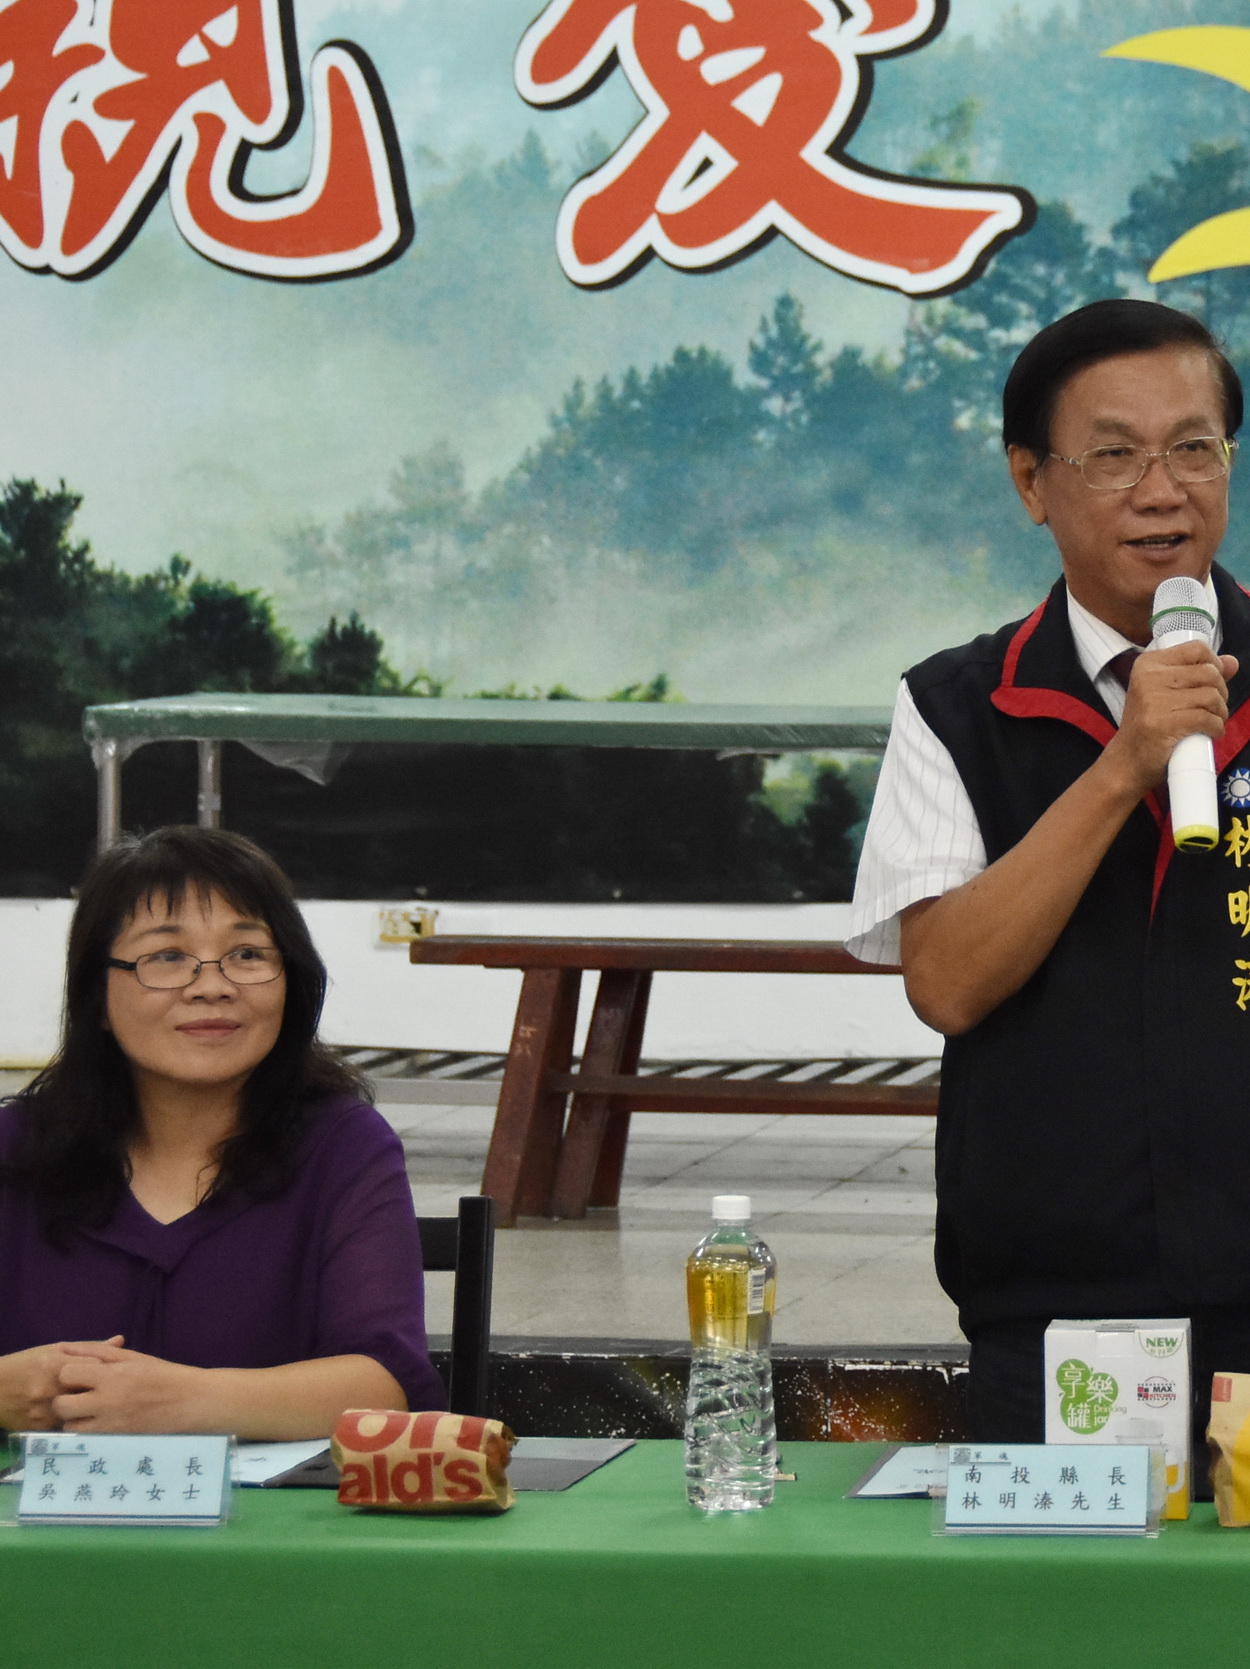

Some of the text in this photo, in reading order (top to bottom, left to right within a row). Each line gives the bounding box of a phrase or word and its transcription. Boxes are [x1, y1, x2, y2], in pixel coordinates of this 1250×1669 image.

[1145, 1337, 1178, 1348] NEW
[42, 1456, 203, 1477] 民政處長
[965, 1464, 1127, 1486] 南投縣長
[38, 1483, 201, 1501] 吳燕玲女士
[961, 1490, 1126, 1511] 林明溱先生
